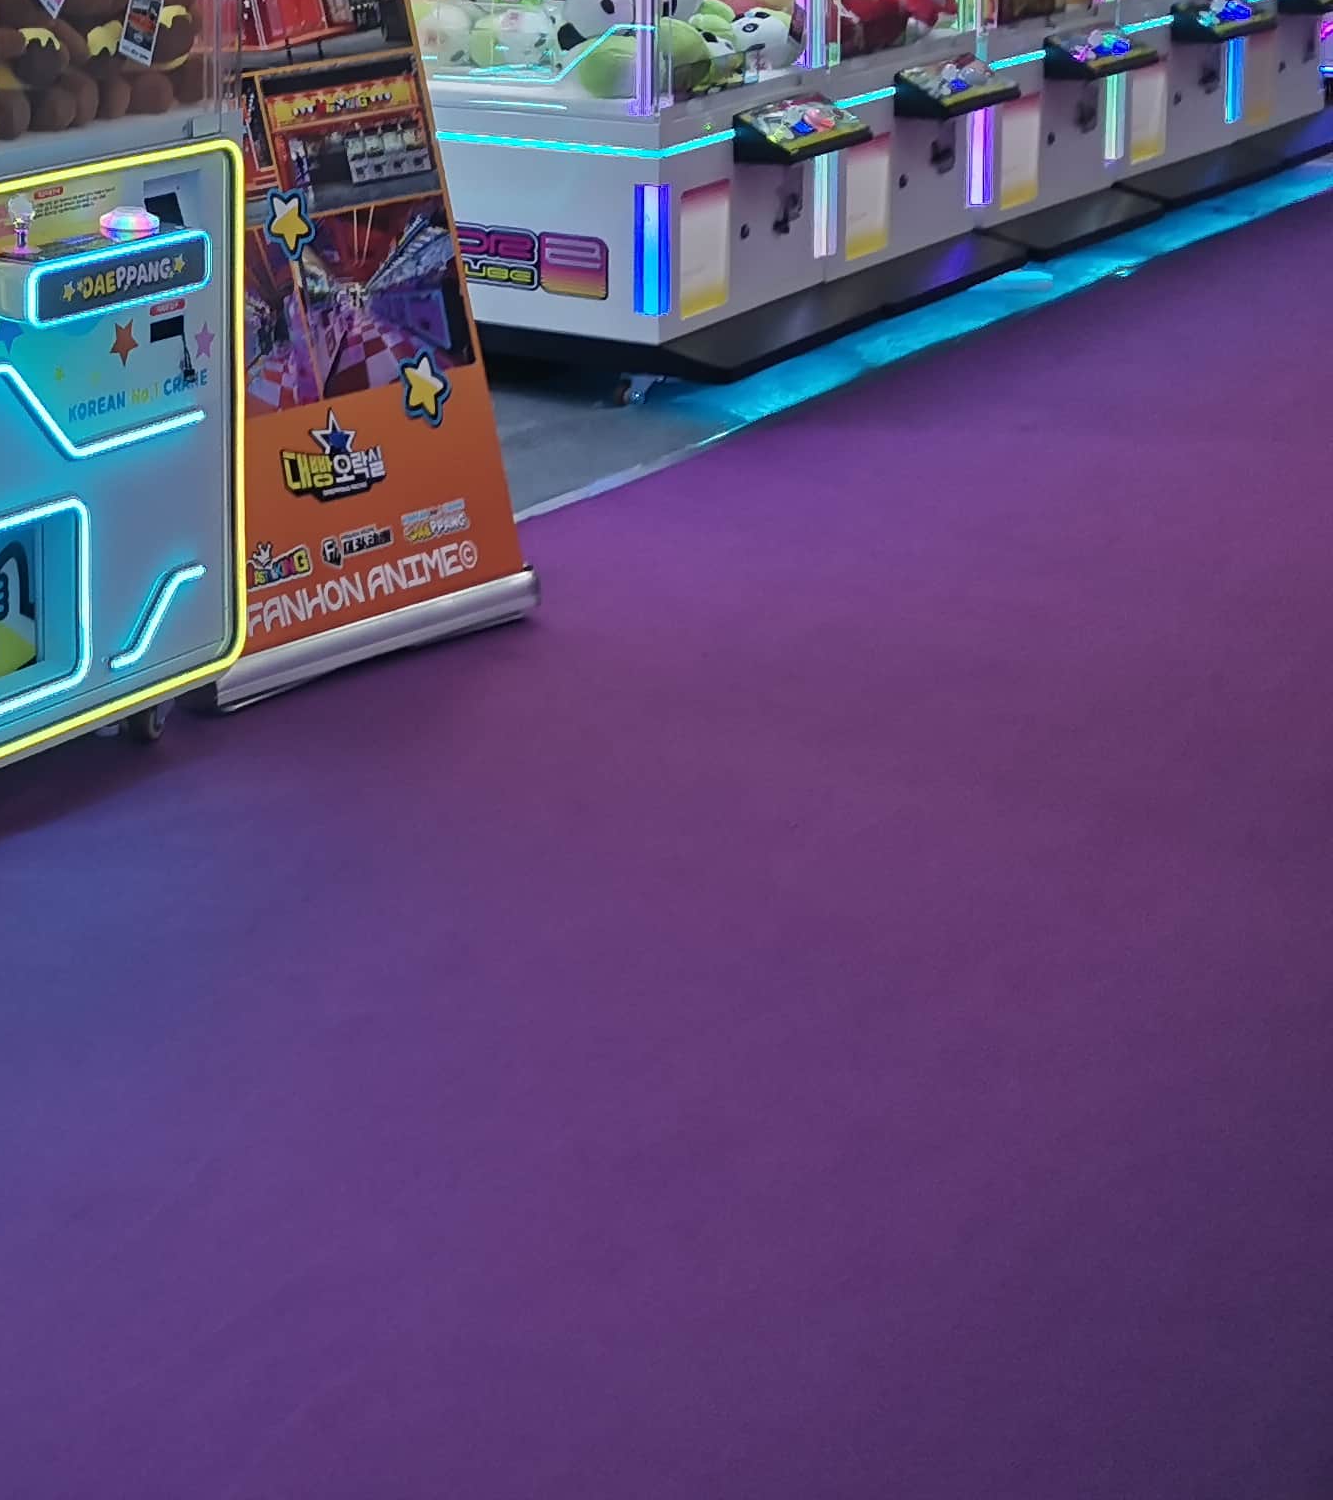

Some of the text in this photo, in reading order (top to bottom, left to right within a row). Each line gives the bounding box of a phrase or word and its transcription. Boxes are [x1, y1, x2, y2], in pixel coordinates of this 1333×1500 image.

[81, 257, 173, 300] DAEPPANG
[464, 263, 533, 285] UBE
[69, 390, 126, 424] KOREAN
[247, 572, 365, 637] FANHON
